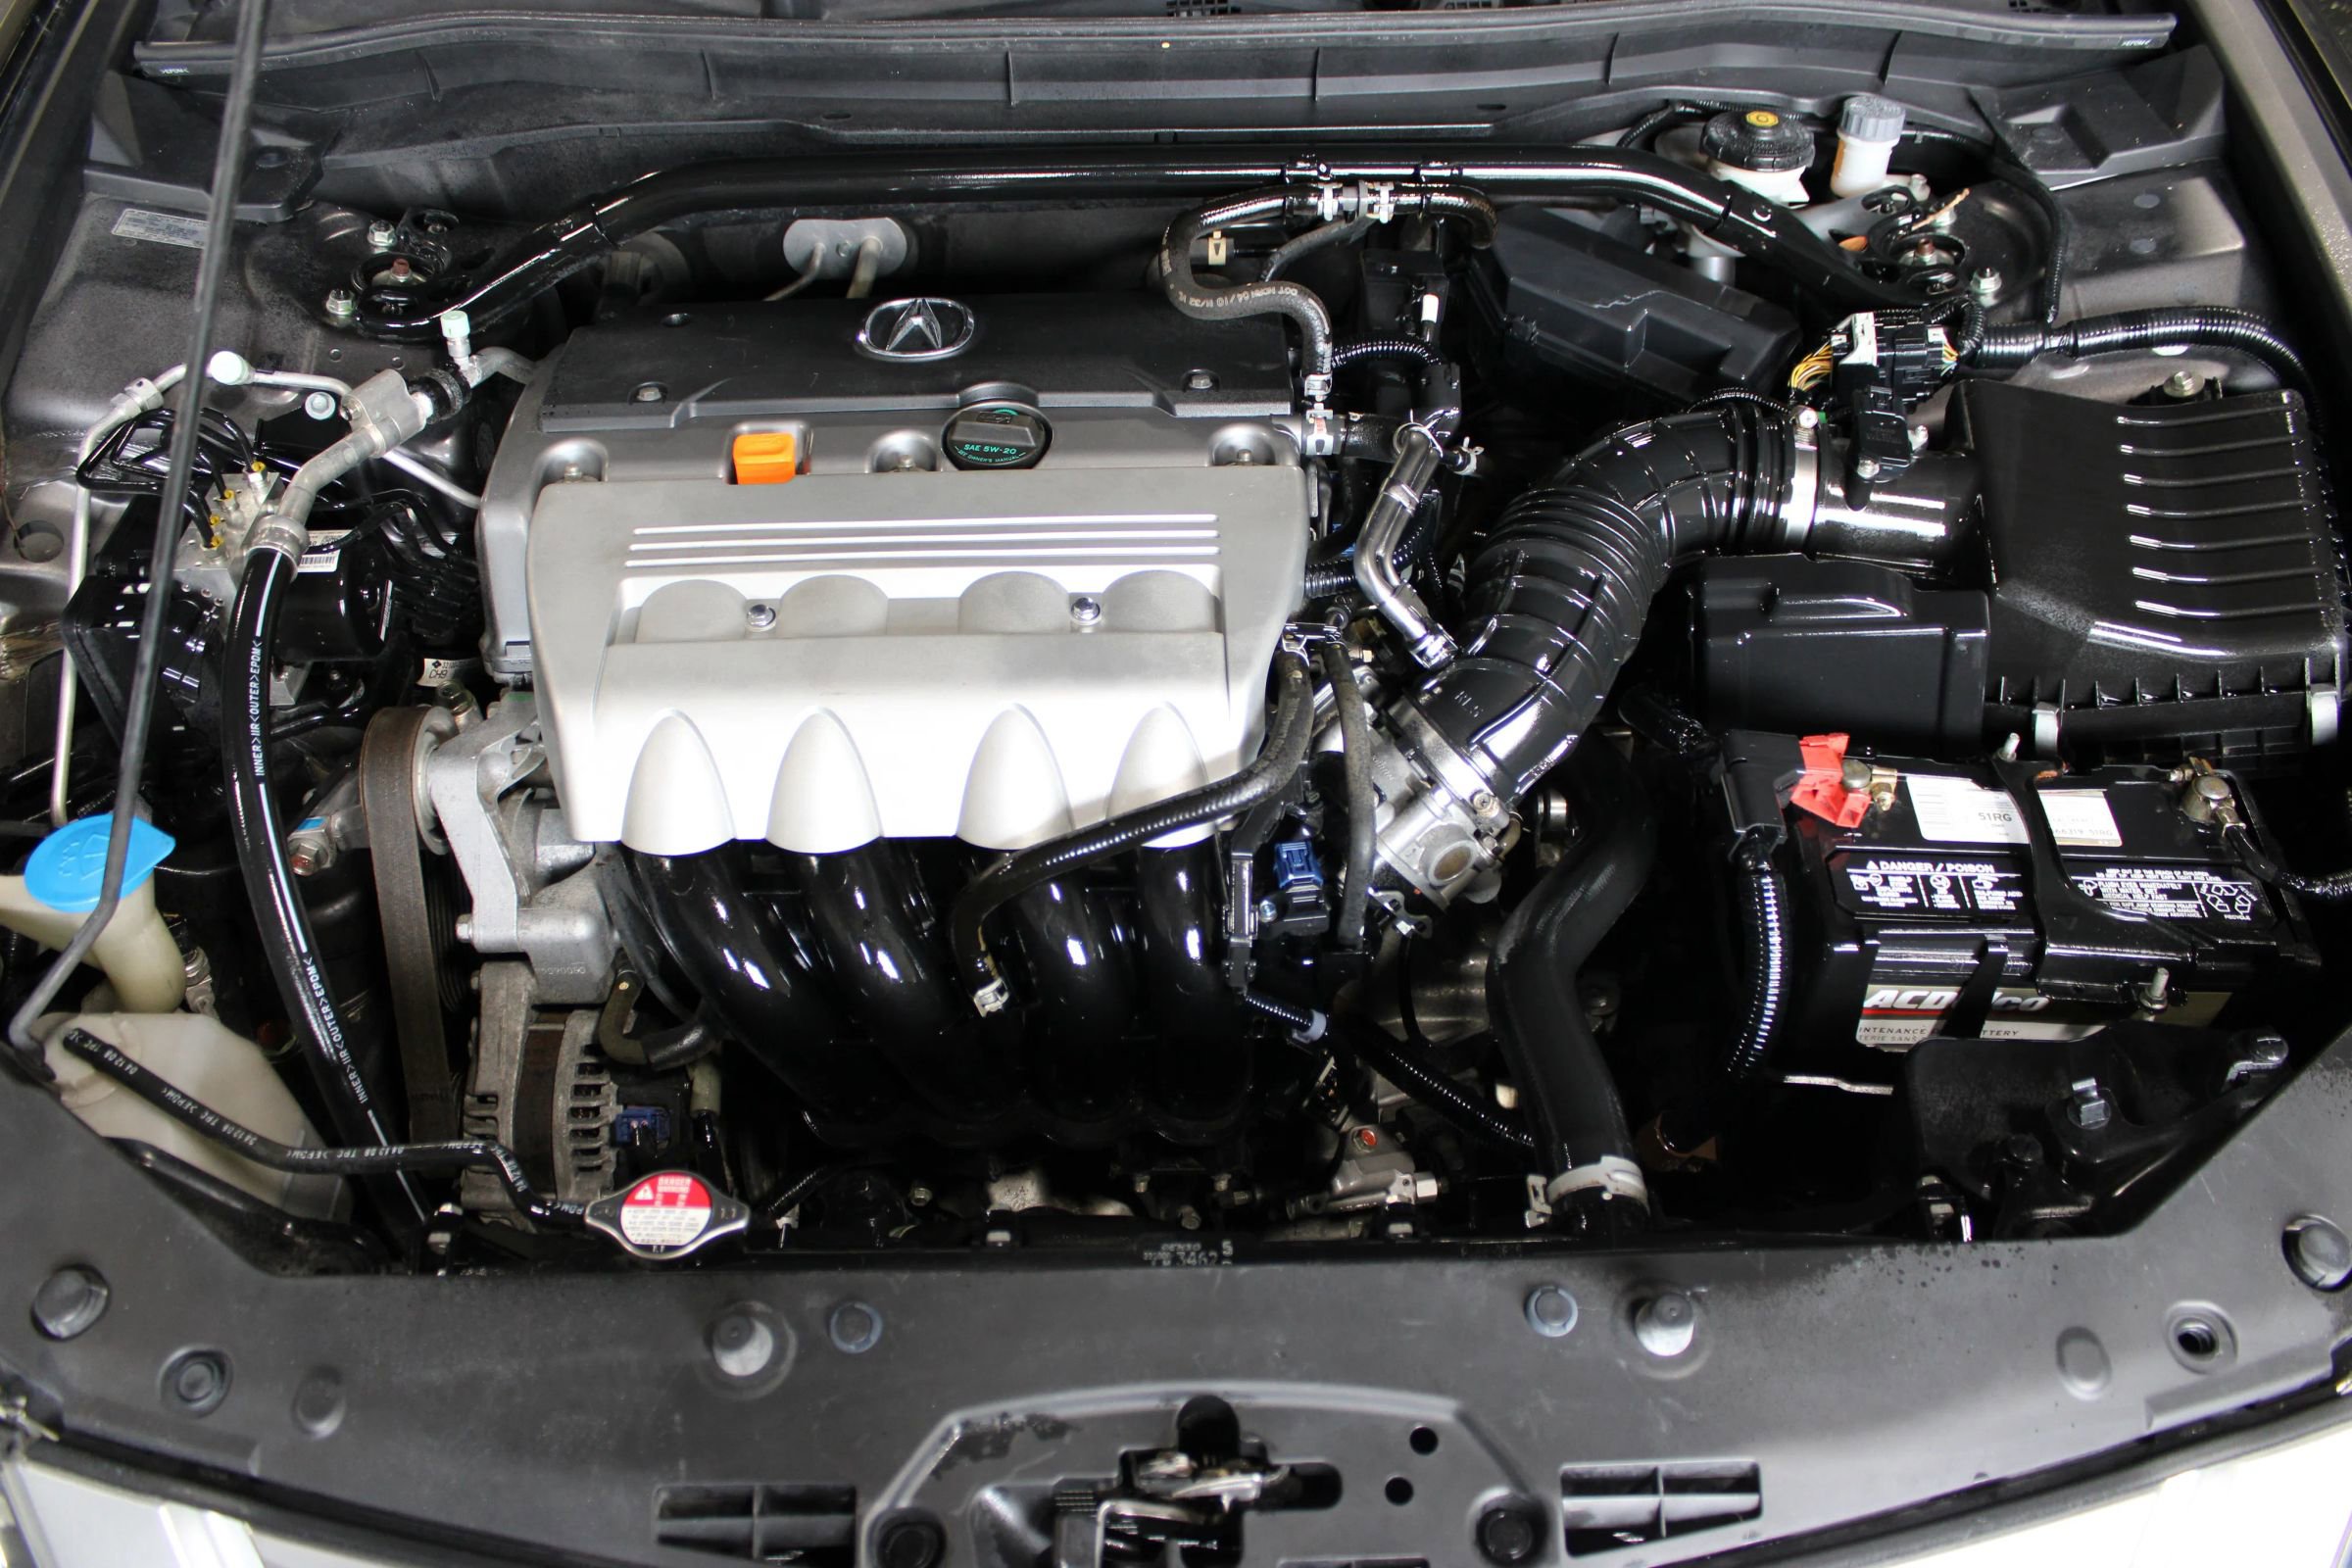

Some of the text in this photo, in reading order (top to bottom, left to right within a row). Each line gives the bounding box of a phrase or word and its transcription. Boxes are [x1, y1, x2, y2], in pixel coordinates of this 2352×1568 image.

[983, 444, 1017, 455] 5W-20
[1978, 811, 2013, 823] 51RG
[1880, 860, 1934, 872] DANGER
[1946, 863, 1995, 873] POISON
[1862, 989, 2051, 1011] ACDlco
[303, 956, 369, 1104] INNER>IIR<OUTER>EPDM<
[1859, 1026, 1926, 1035] INTENANCE
[552, 1200, 585, 1216] PDM<
